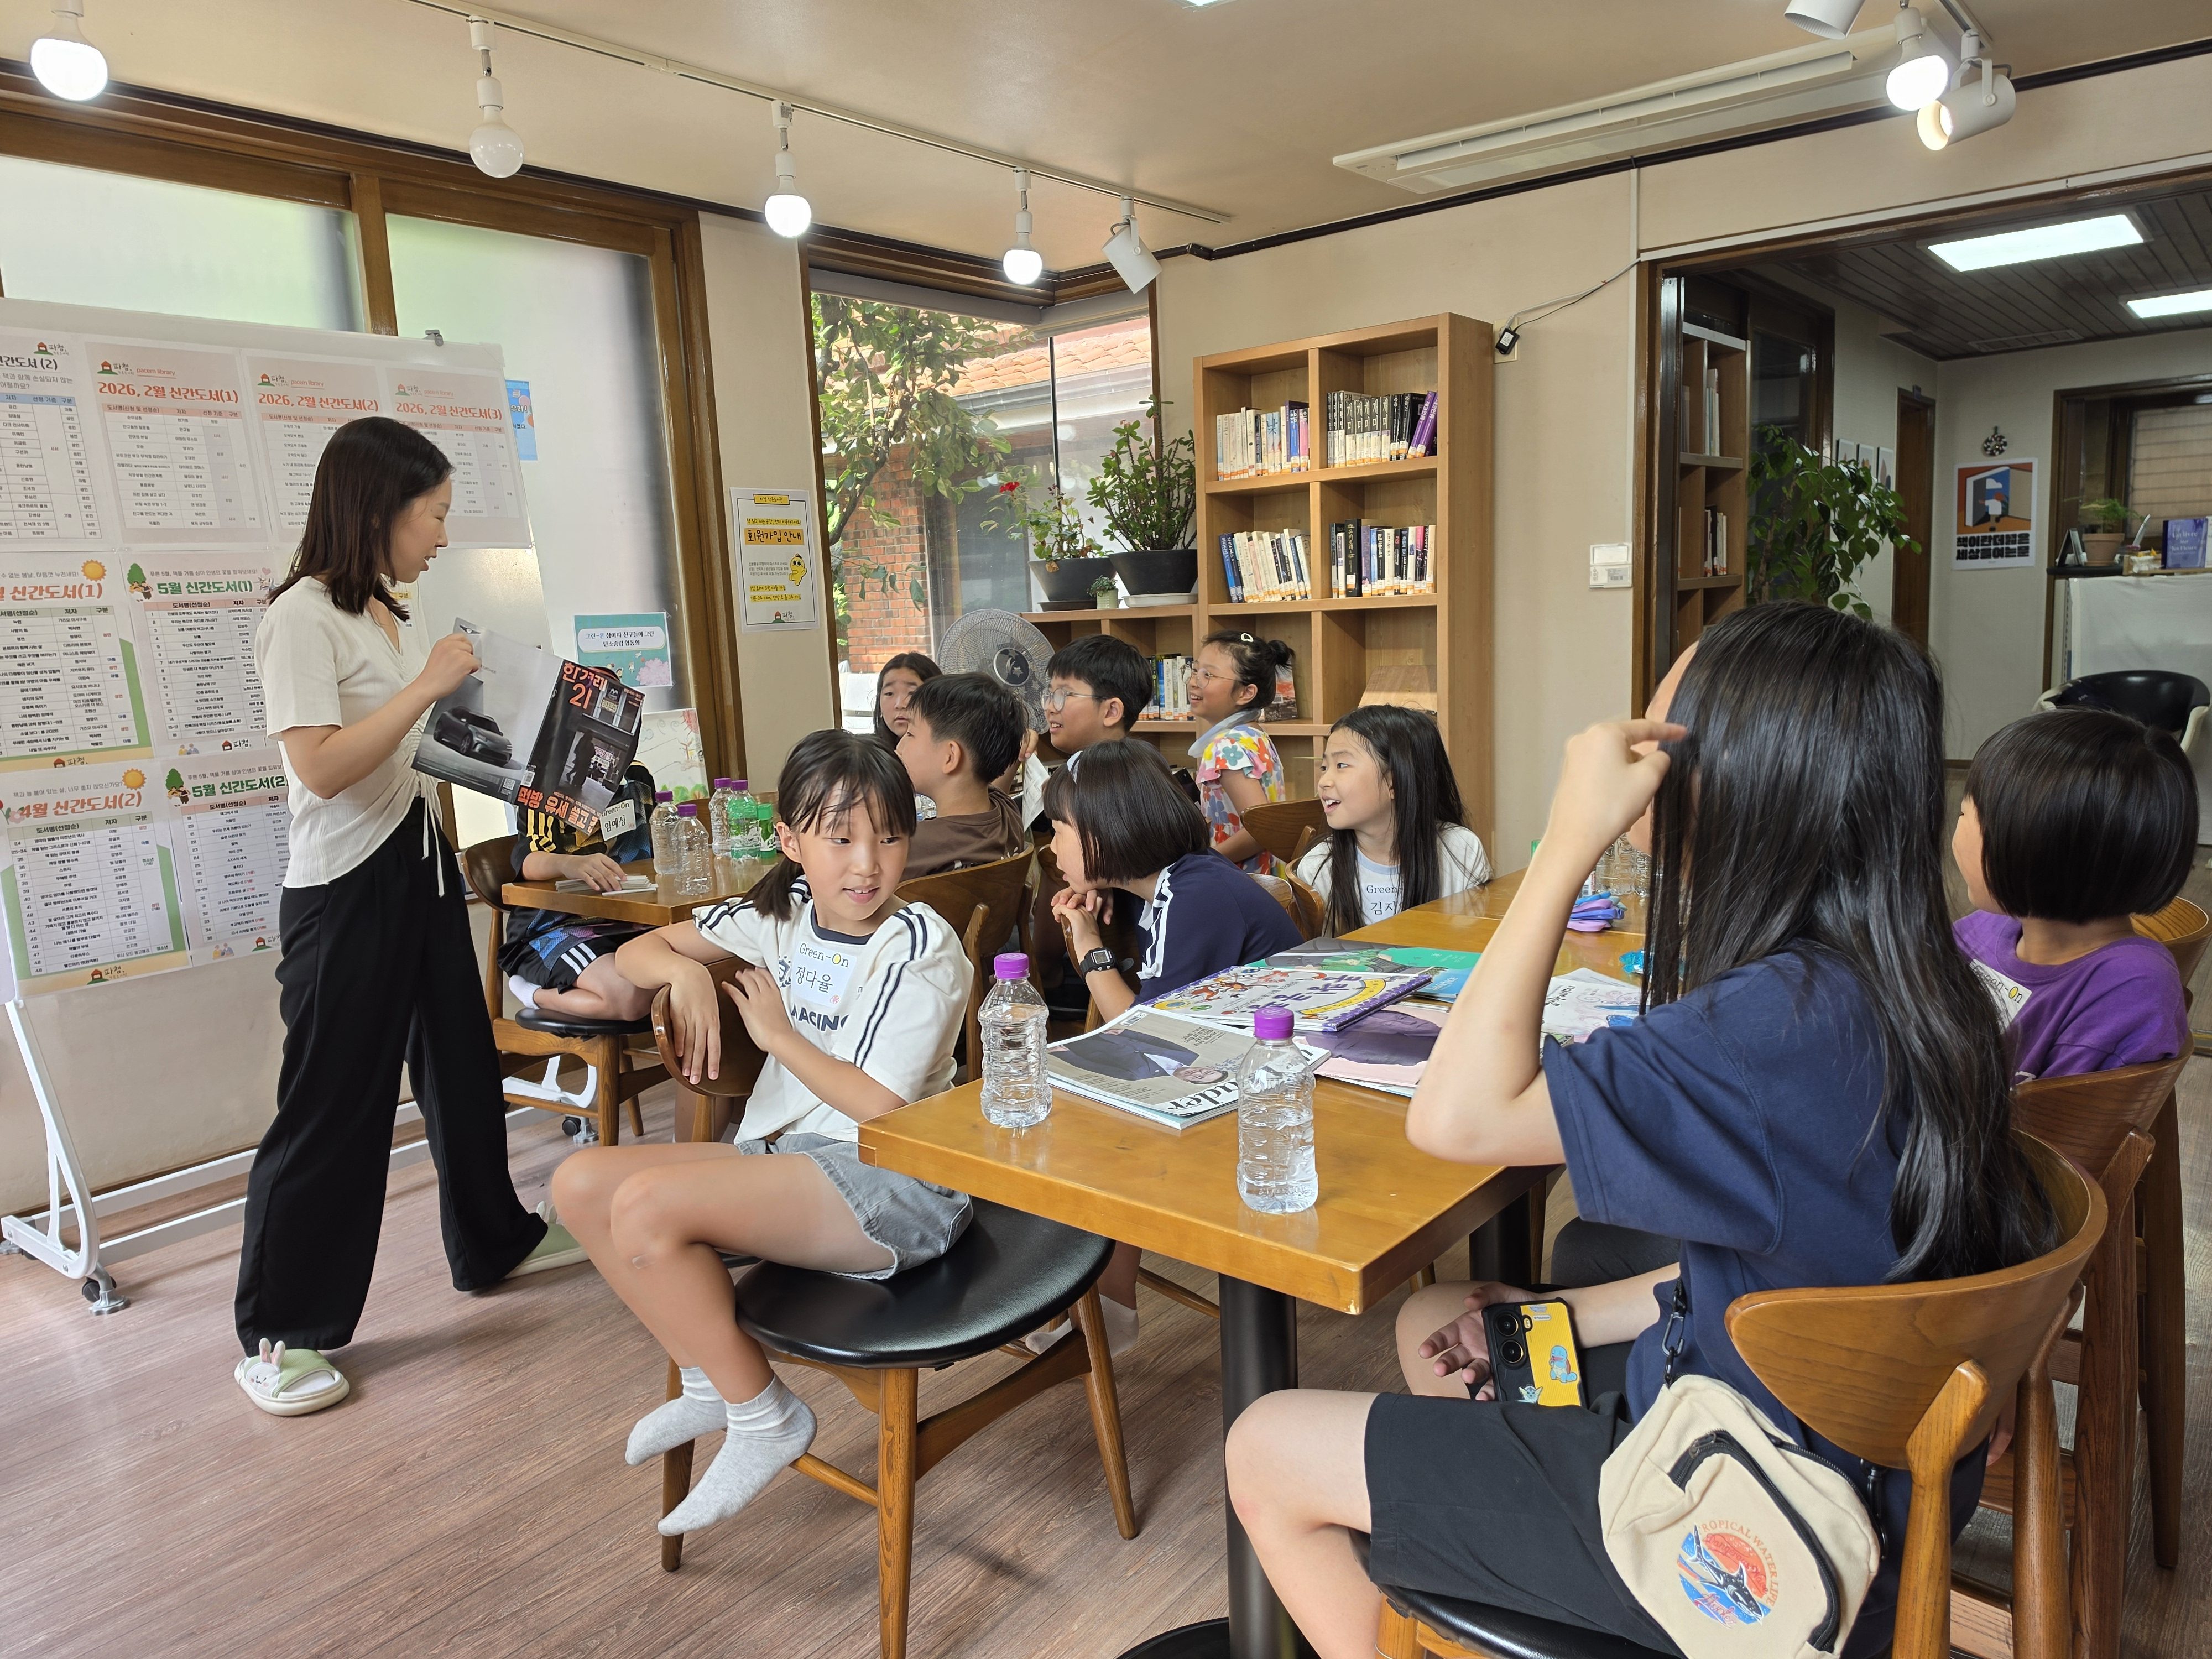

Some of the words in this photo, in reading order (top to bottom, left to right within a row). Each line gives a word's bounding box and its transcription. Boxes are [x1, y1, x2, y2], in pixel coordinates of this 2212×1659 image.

[158, 368, 175, 377] library
[97, 382, 140, 397] 2026,
[143, 385, 167, 399] 2월
[169, 387, 239, 403] 신간도서(1)
[258, 393, 294, 407] 2026,
[296, 396, 316, 408] 2월
[318, 397, 379, 412] 신간도서(2)
[395, 403, 427, 415] 2026,
[429, 405, 447, 416] 2월
[449, 406, 502, 420] 신간도서(3)
[748, 529, 781, 543] 회원가입
[784, 531, 801, 542] 안내
[9, 582, 103, 601] 신간도서(1)
[157, 582, 182, 595] 5월
[185, 580, 253, 594] 신간도서(1)
[563, 662, 608, 691] 한겨레
[569, 683, 592, 709] 21
[192, 784, 216, 798] 5월
[19, 803, 48, 818] 4월
[52, 791, 142, 816] 신간도서(2)
[545, 795, 570, 819] 유세
[604, 815, 626, 832] 임예성
[1366, 884, 1403, 894] Green-
[800, 943, 850, 968] Green-On
[795, 966, 833, 993] 정다율
[1753, 1535, 1778, 1578] WATER
[1765, 1580, 1779, 1607] LIFE
